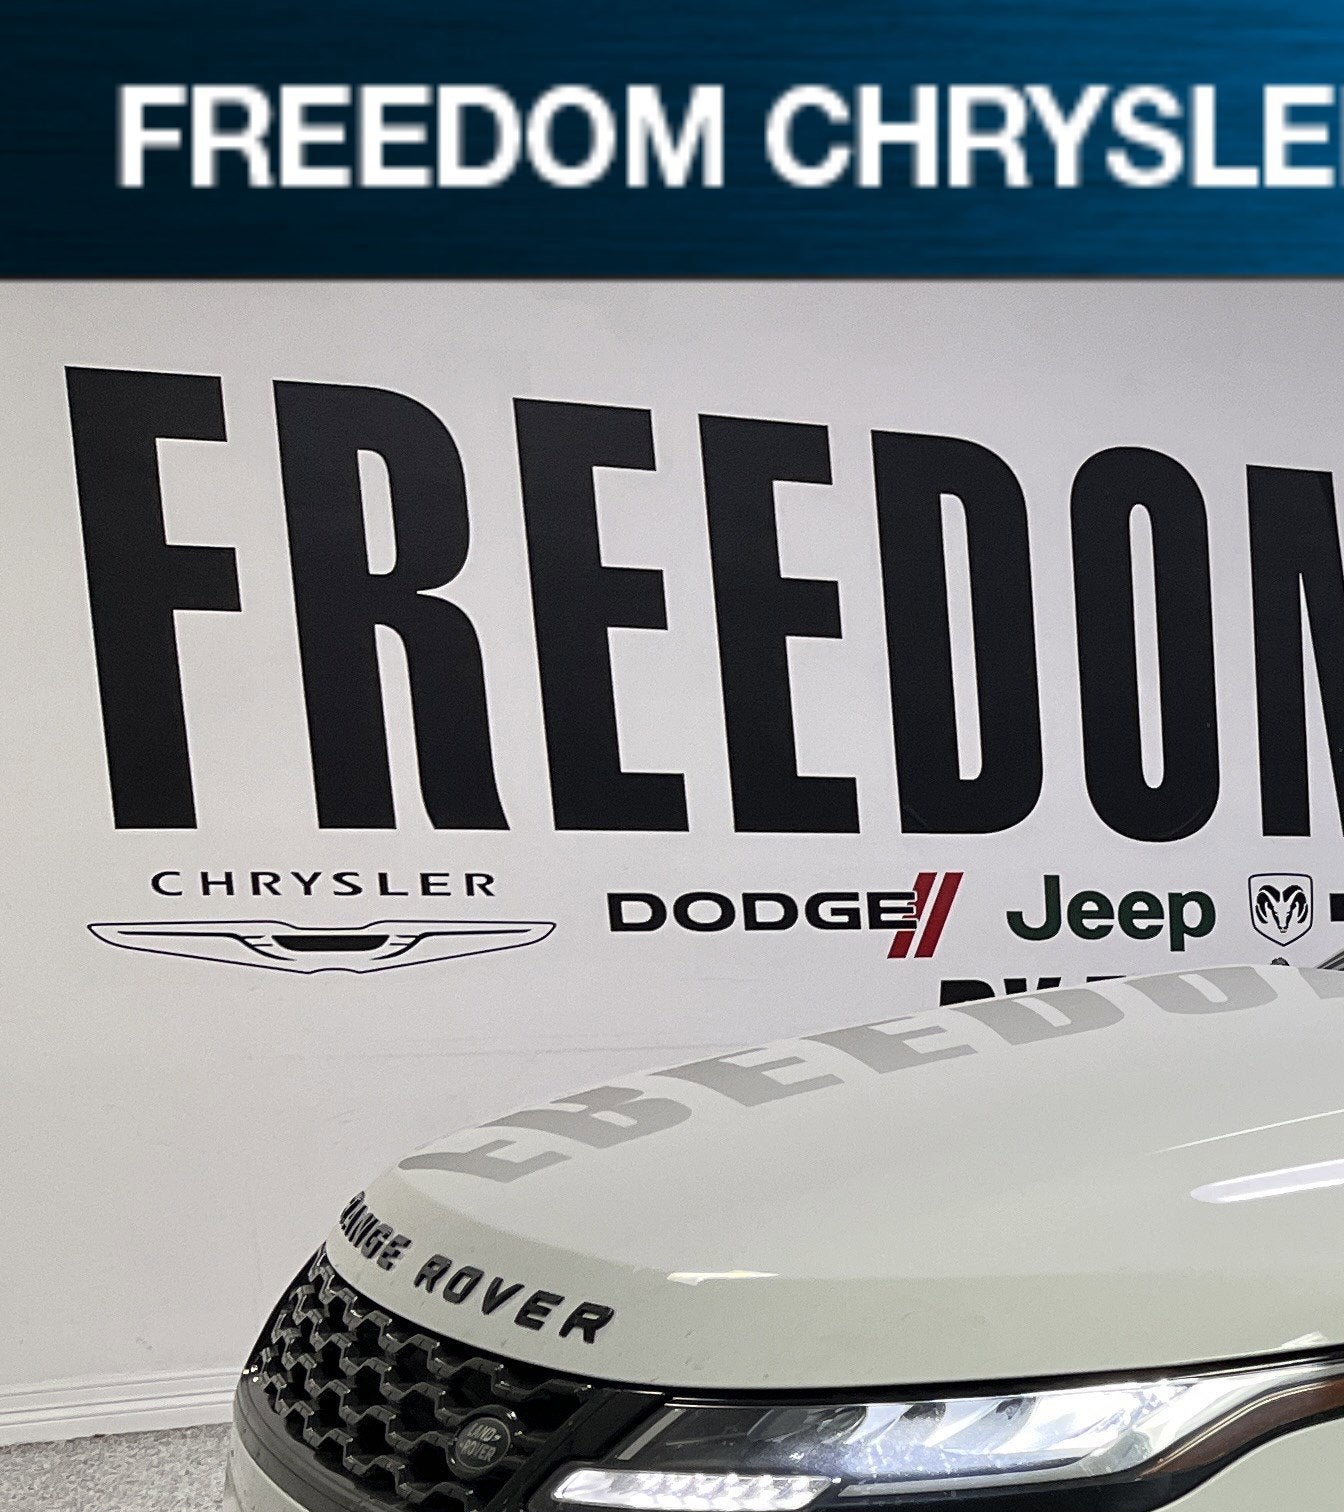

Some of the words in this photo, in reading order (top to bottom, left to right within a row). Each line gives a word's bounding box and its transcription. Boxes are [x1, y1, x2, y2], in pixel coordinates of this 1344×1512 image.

[150, 870, 497, 897] CHRYSLER
[605, 890, 918, 932] DODGE
[1006, 874, 1217, 952] Jeep
[412, 1254, 615, 1344] ROVER
[466, 1422, 497, 1442] LAND
[461, 1439, 498, 1462] ROVER
